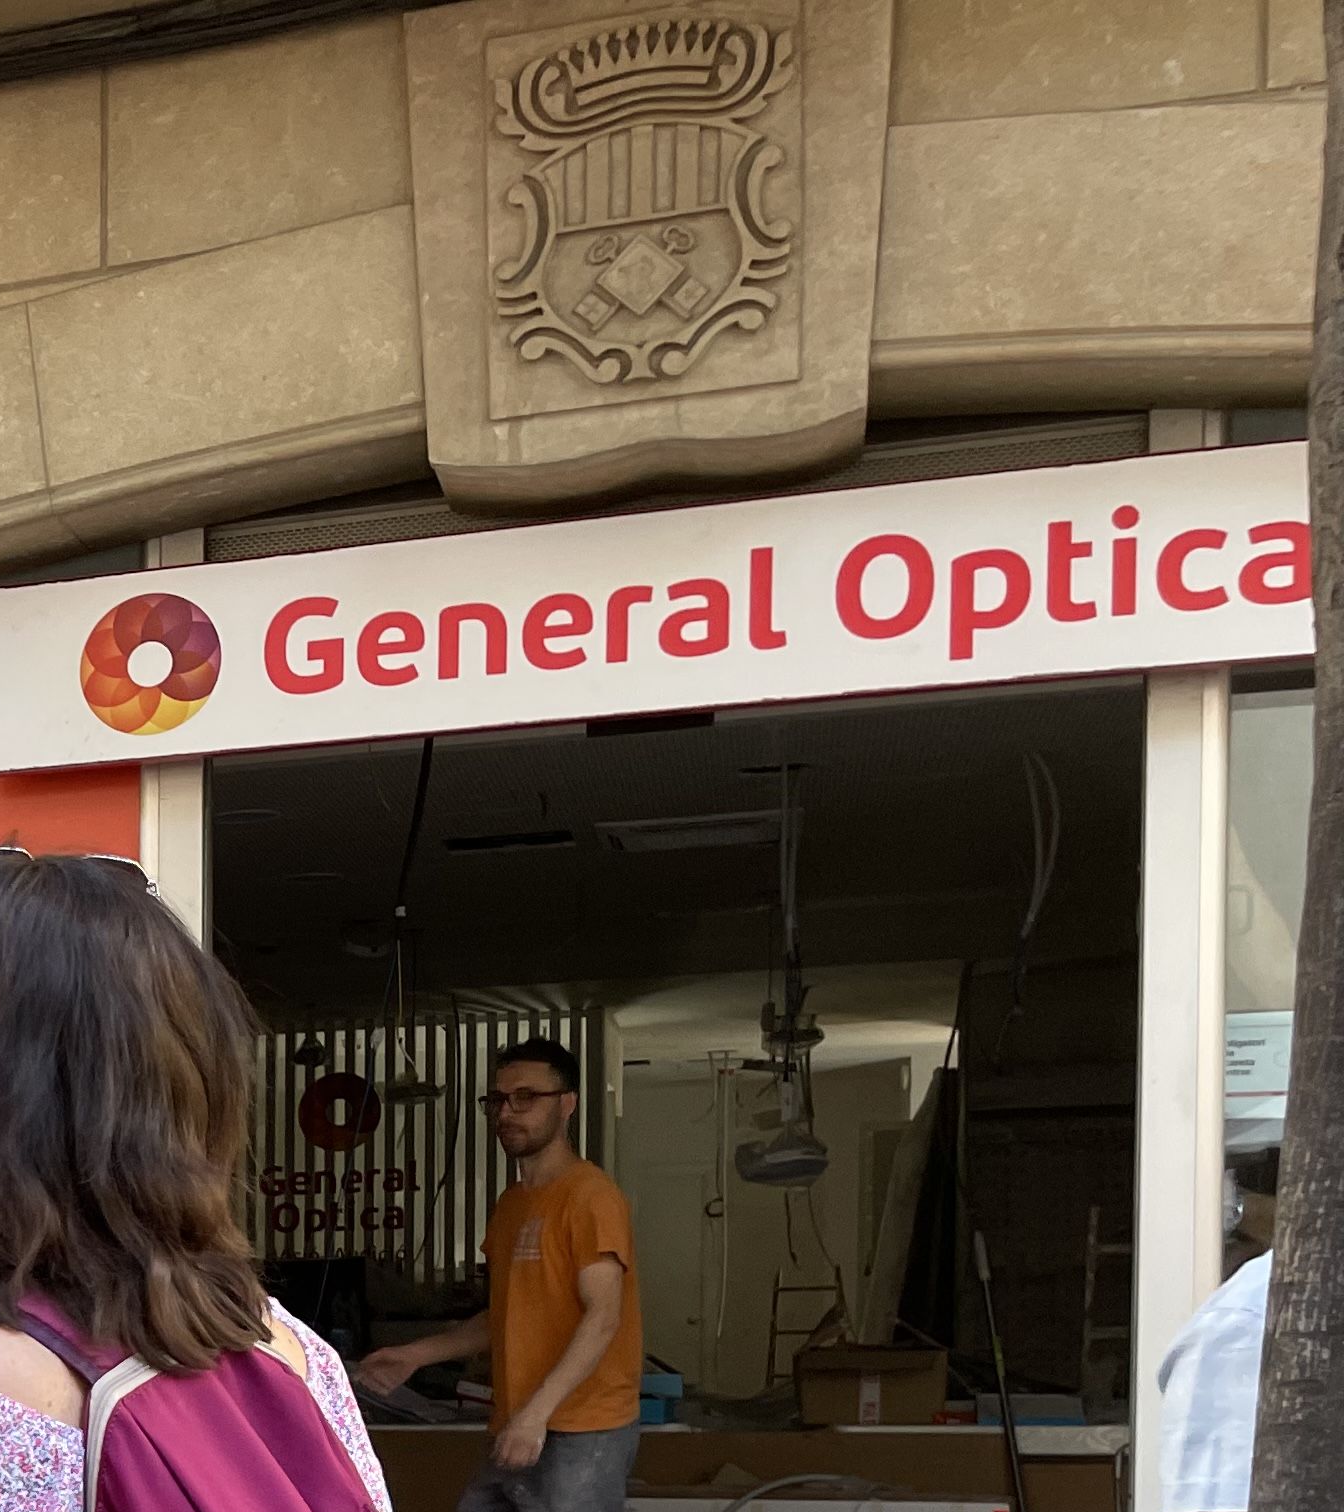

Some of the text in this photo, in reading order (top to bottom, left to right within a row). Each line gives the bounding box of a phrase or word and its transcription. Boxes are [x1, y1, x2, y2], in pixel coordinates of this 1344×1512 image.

[264, 504, 1313, 697] General Optica
[259, 1159, 420, 1196] General
